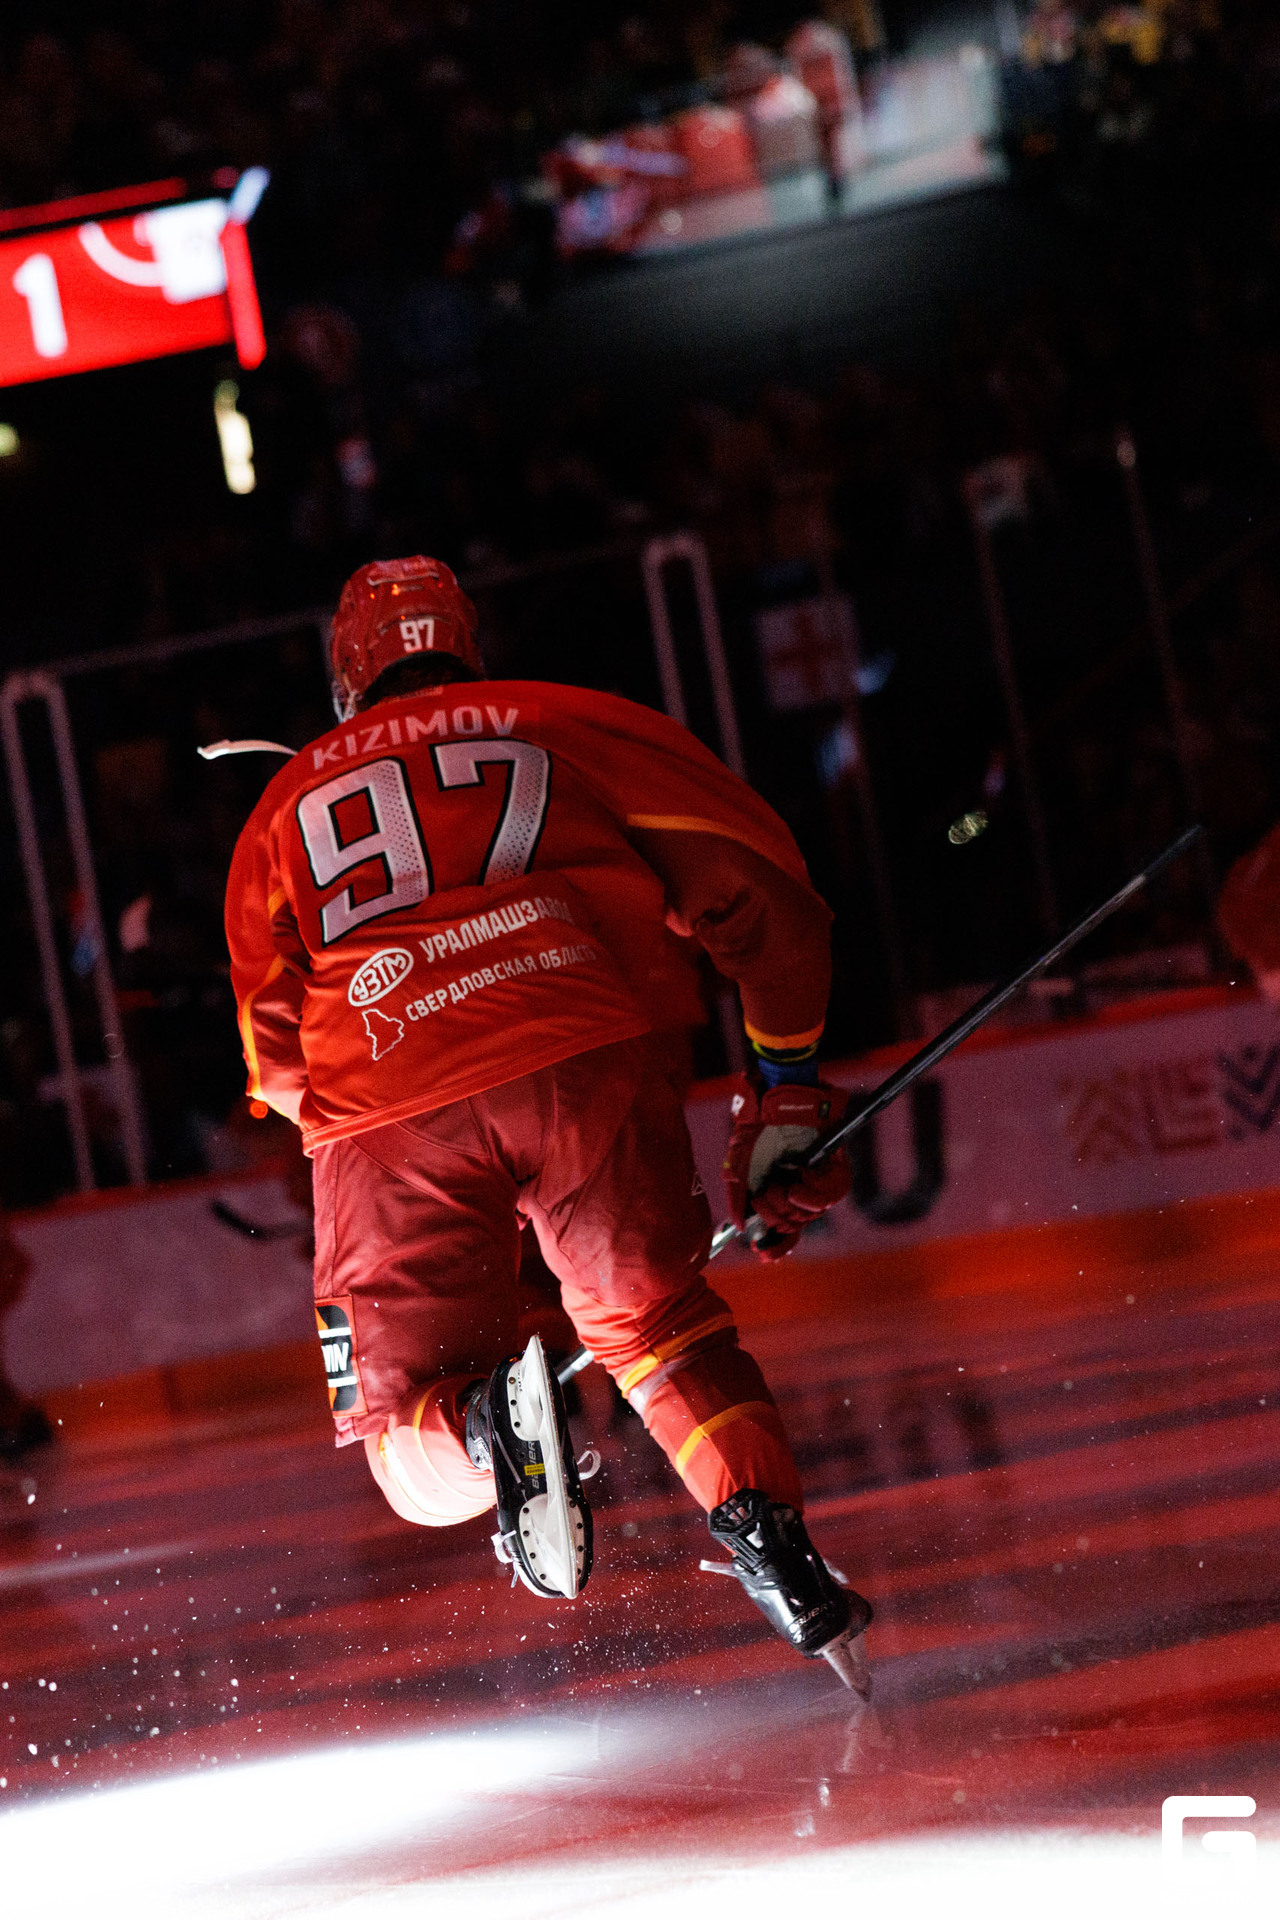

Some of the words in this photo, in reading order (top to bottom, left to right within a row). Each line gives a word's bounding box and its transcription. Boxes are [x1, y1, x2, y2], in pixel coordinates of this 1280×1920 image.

[12, 252, 68, 358] 1
[400, 617, 435, 653] 97
[313, 705, 519, 770] KIZIMOV
[296, 737, 553, 947] 97
[405, 955, 537, 1022] СВЕРДЛОВСКАЯ
